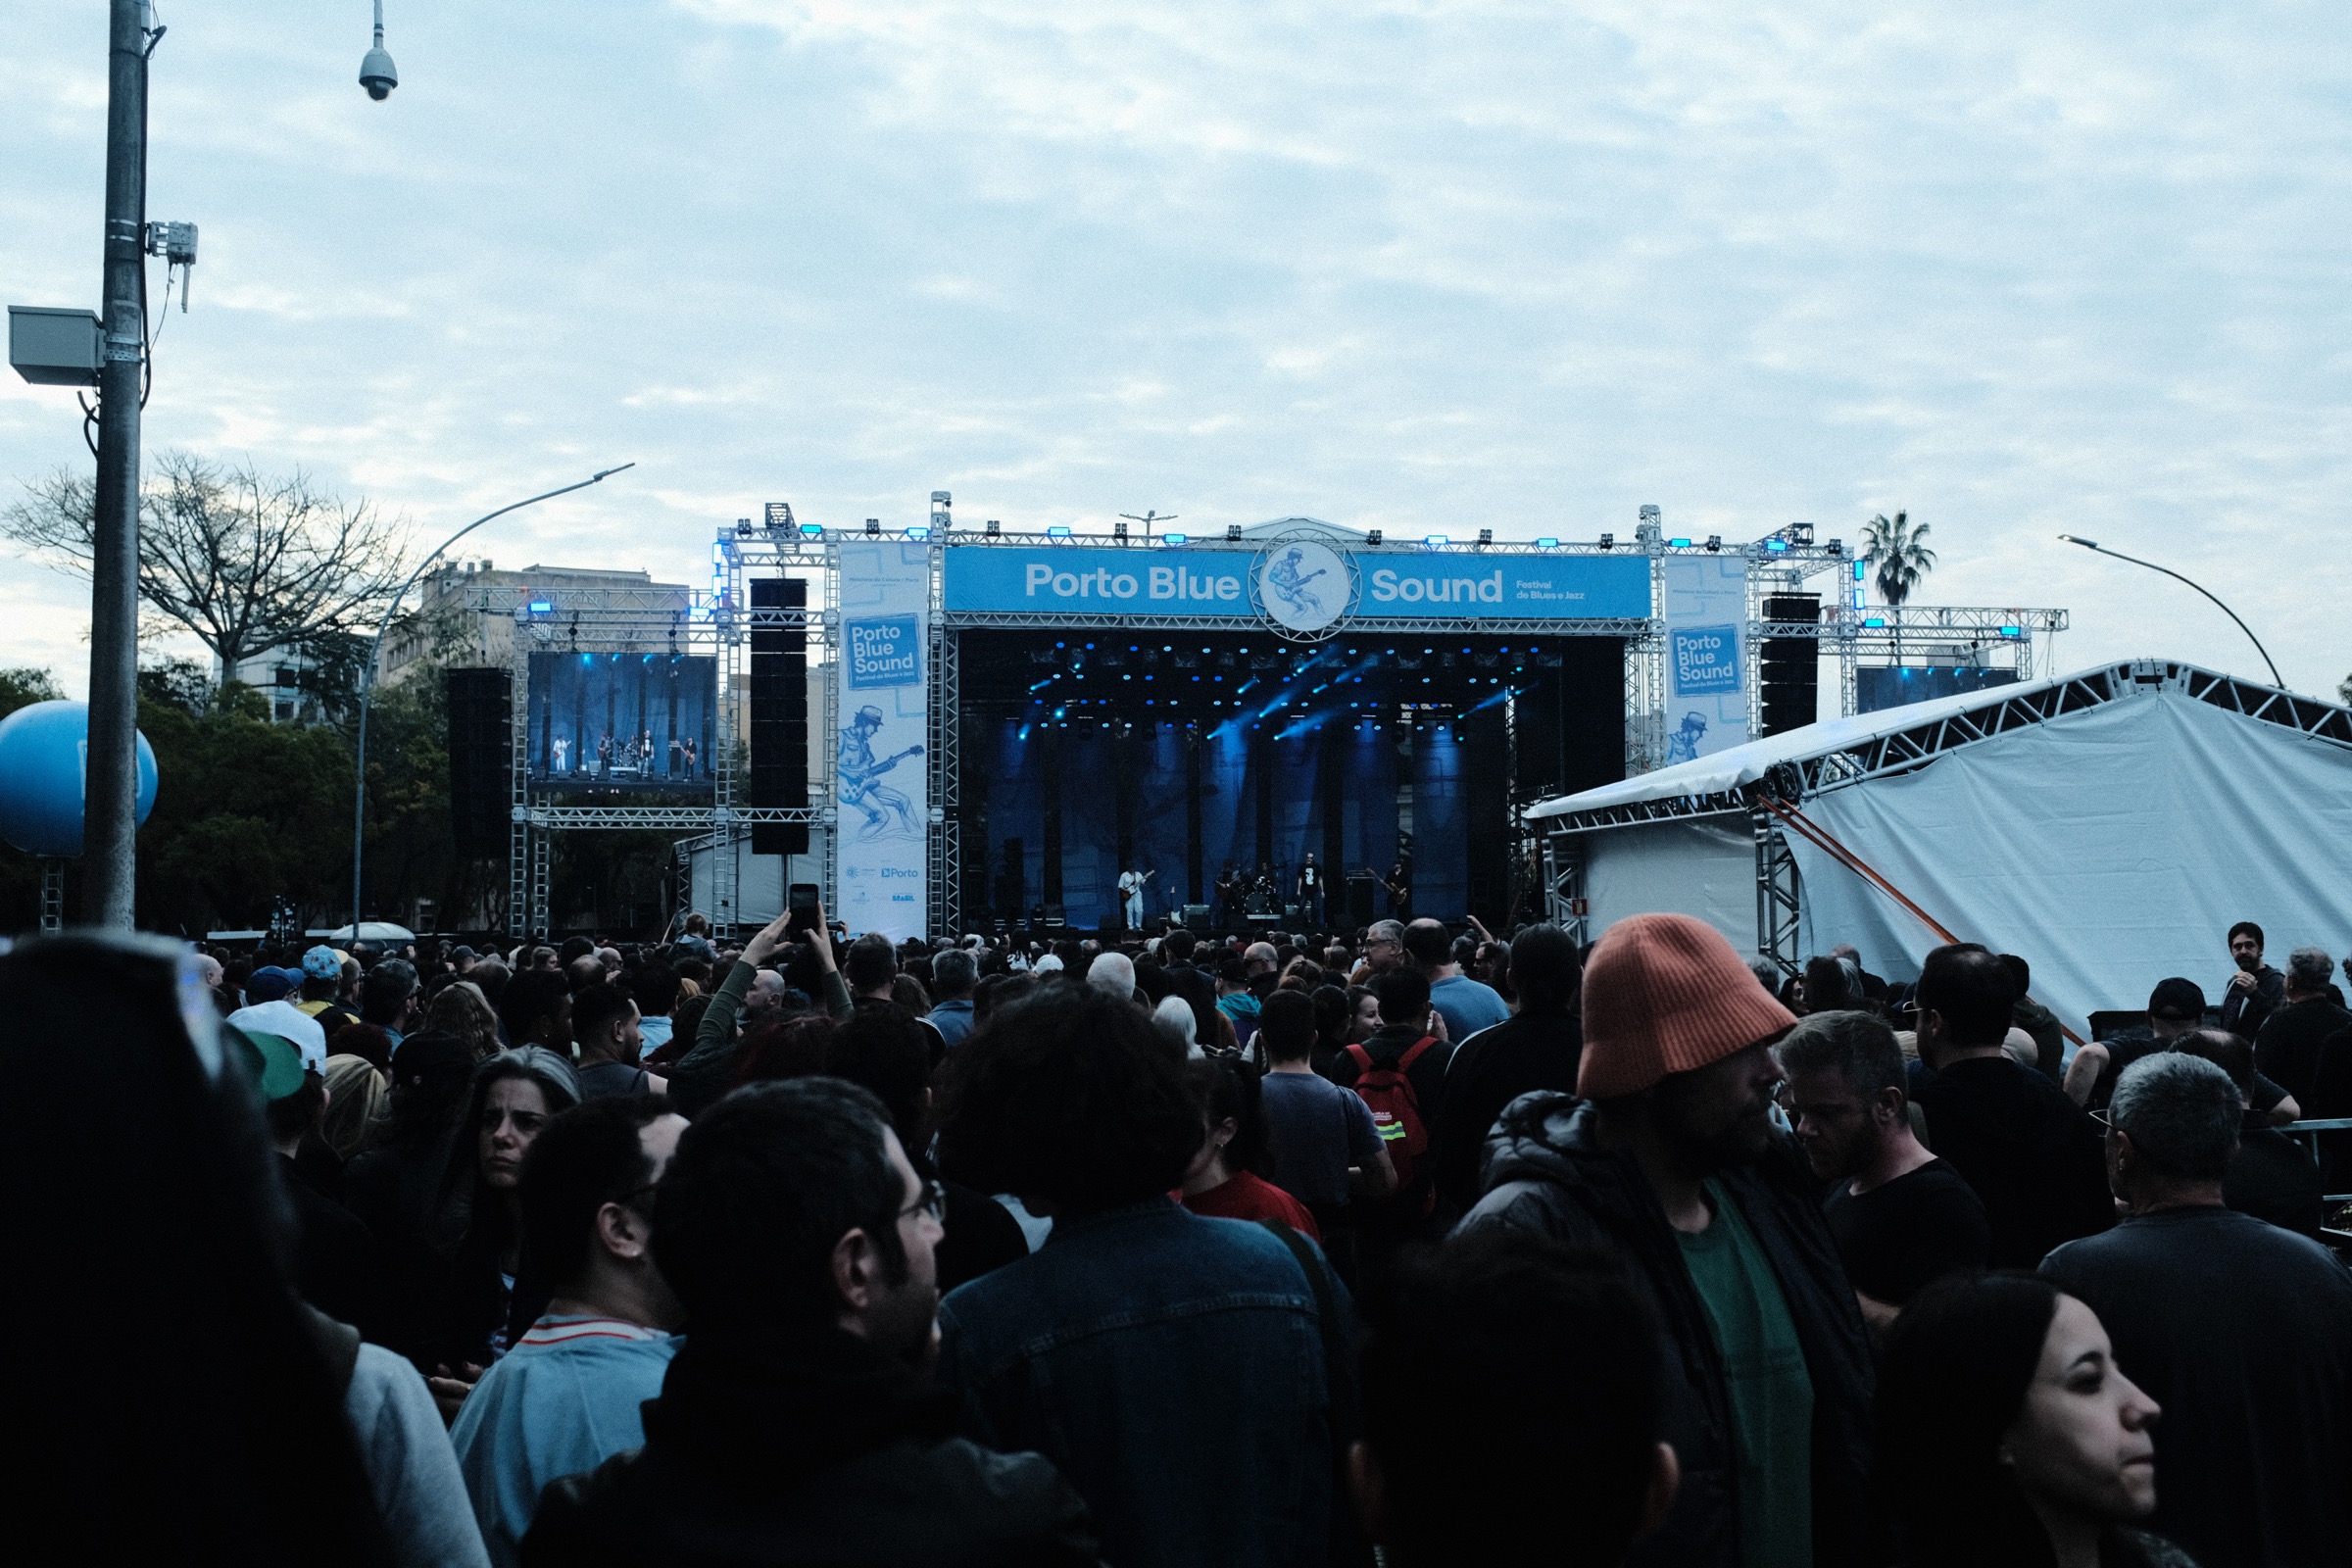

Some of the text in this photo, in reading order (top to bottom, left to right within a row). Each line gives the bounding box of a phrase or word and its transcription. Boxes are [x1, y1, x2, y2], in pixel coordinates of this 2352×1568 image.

[1026, 564, 1502, 602] Porto Blue Sound
[1516, 580, 1551, 589] Festival
[852, 624, 901, 642] Porto
[853, 641, 894, 659] Blue
[1677, 635, 1721, 652] Porto
[855, 652, 913, 674] Sound
[1678, 650, 1715, 666] Blue
[1679, 661, 1734, 681] Sound
[891, 868, 918, 878] Porto
